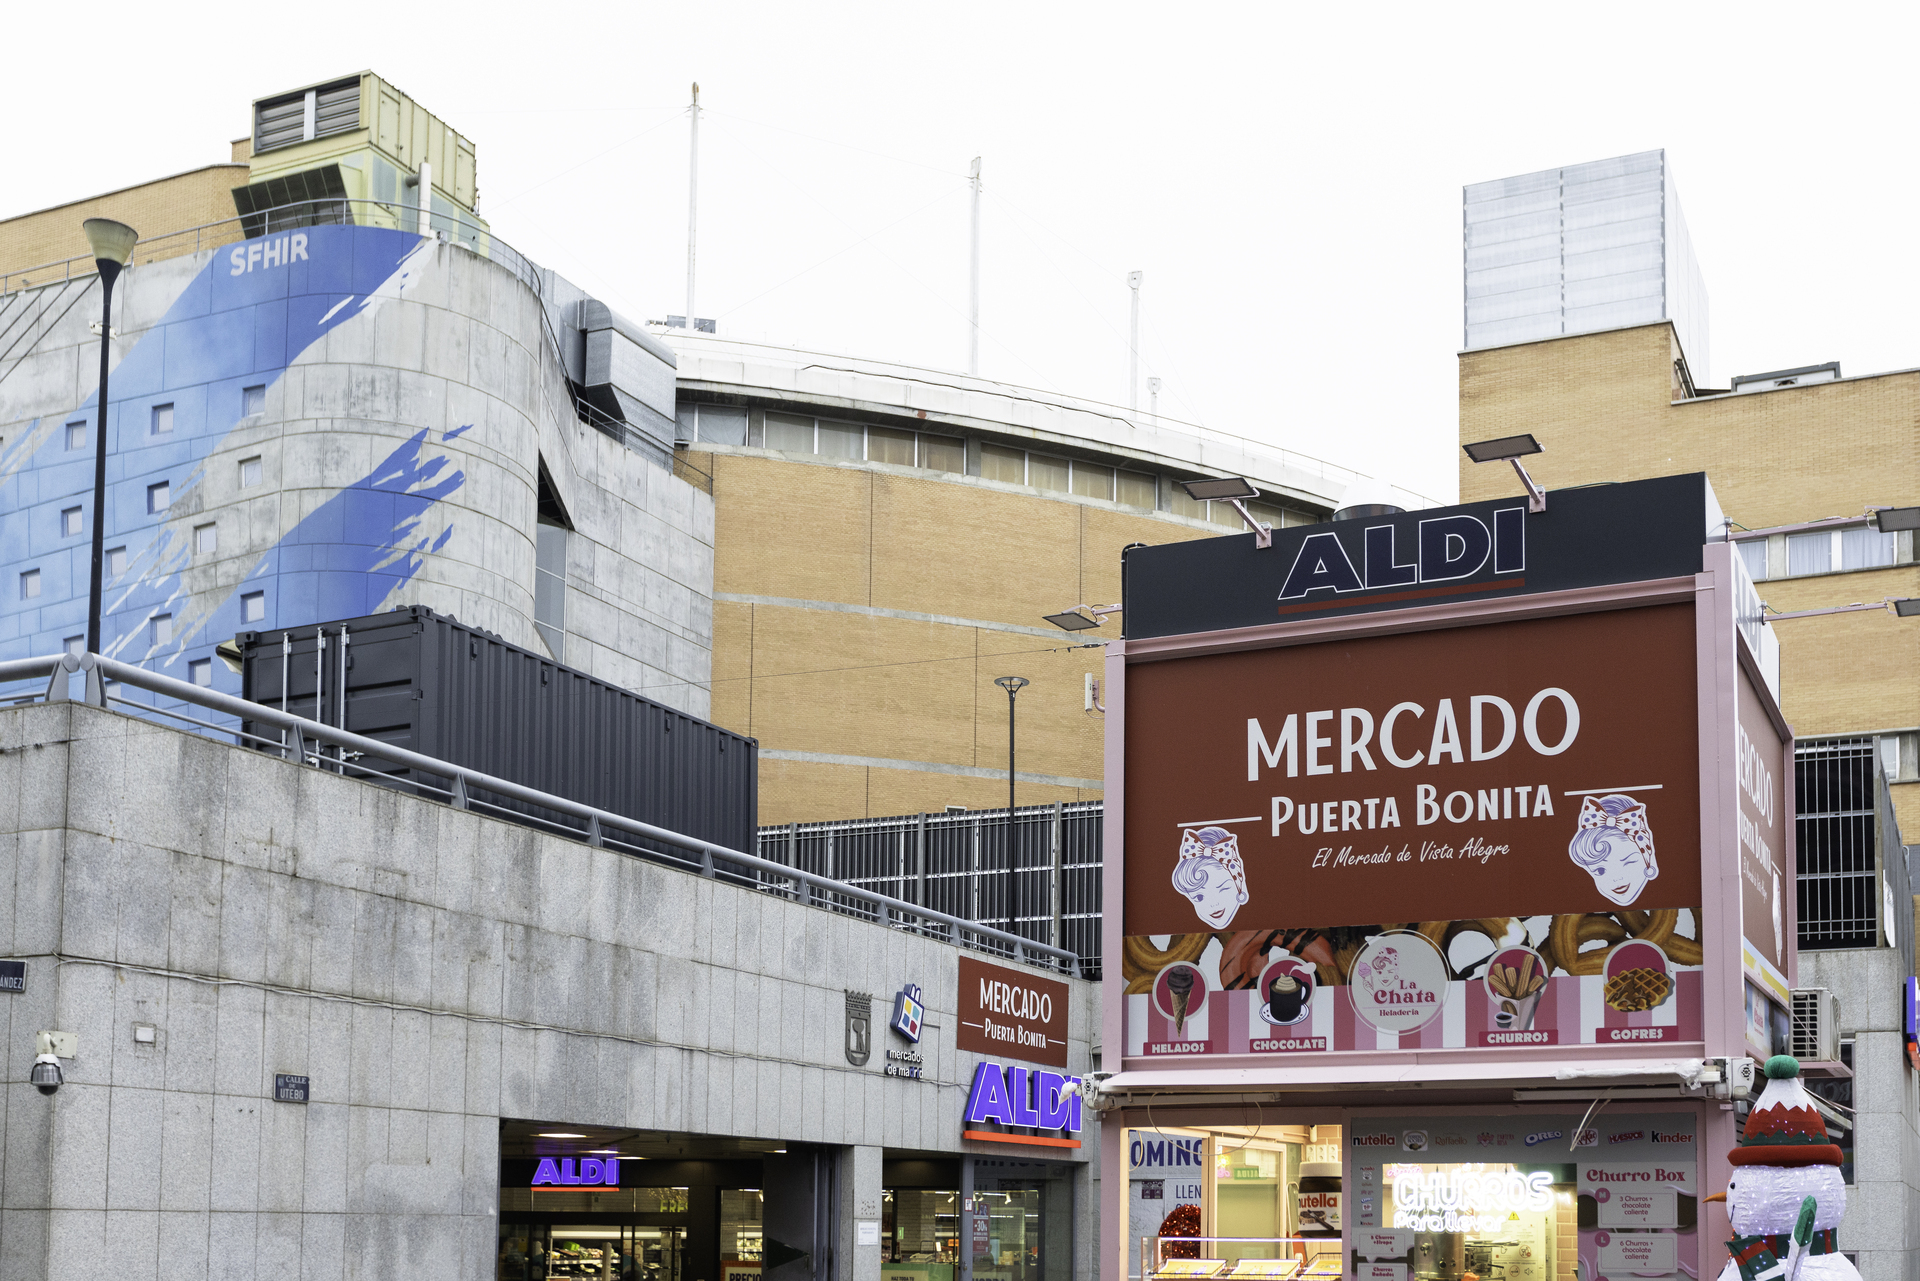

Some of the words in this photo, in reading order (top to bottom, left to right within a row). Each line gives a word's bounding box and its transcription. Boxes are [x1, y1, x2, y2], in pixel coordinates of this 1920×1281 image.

[230, 232, 310, 276] SFHIR
[1278, 506, 1526, 600] ALDI
[1246, 686, 1582, 782] MERCADO
[1737, 720, 1773, 828] ERCADO
[1270, 795, 1402, 838] PUERTA
[1415, 783, 1555, 827] BONITA
[1739, 808, 1755, 855] UERTA
[1312, 847, 1333, 868] El
[1333, 845, 1392, 868] Mercado
[1396, 843, 1412, 862] de
[1419, 840, 1454, 863] Vista
[1459, 836, 1510, 864] Alegre
[1400, 979, 1417, 990] La
[979, 978, 1052, 1024] MERCADO
[1374, 989, 1436, 1004] Chata
[984, 1018, 1015, 1043] PUERTA
[1017, 1029, 1046, 1049] BONITA
[1487, 1031, 1549, 1044] CHURROS
[1610, 1027, 1664, 1040] GOFRES
[1151, 1042, 1205, 1054] HELADOS
[1253, 1038, 1326, 1050] CHOCOLATE
[889, 1050, 924, 1063] mercados
[887, 1065, 897, 1075] de
[898, 1067, 924, 1079] madrid
[285, 1075, 307, 1085] CALLE
[279, 1088, 304, 1100] UTEBO
[965, 1061, 1082, 1133] ALDI
[1352, 1133, 1396, 1146] nutella
[1524, 1131, 1563, 1145] OREO
[532, 1158, 619, 1186] ALDI
[1586, 1168, 1651, 1182] Churro
[1655, 1168, 1686, 1182] Box
[1393, 1171, 1554, 1212] CHURROS
